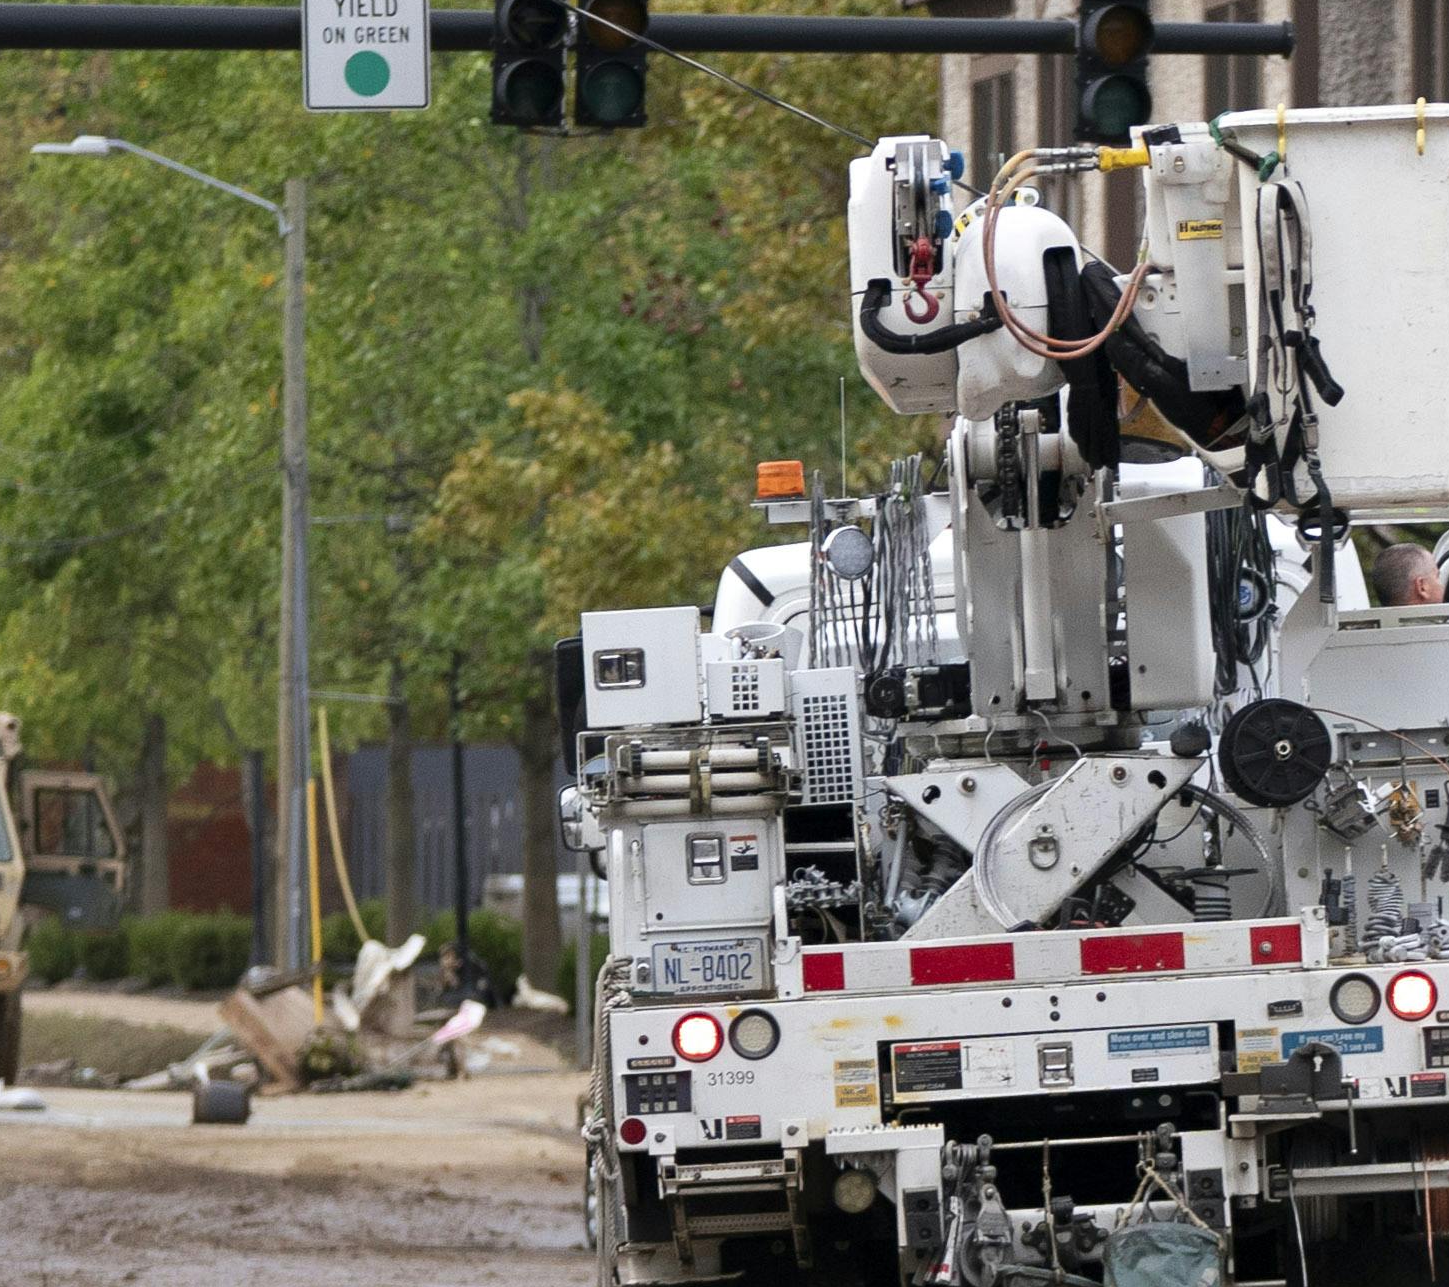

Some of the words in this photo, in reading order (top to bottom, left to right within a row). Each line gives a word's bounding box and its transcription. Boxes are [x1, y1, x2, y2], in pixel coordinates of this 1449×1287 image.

[323, 27, 345, 44] ON
[354, 26, 409, 43] GREEN
[664, 953, 753, 985] NL-8402
[707, 1070, 755, 1087] 31399
